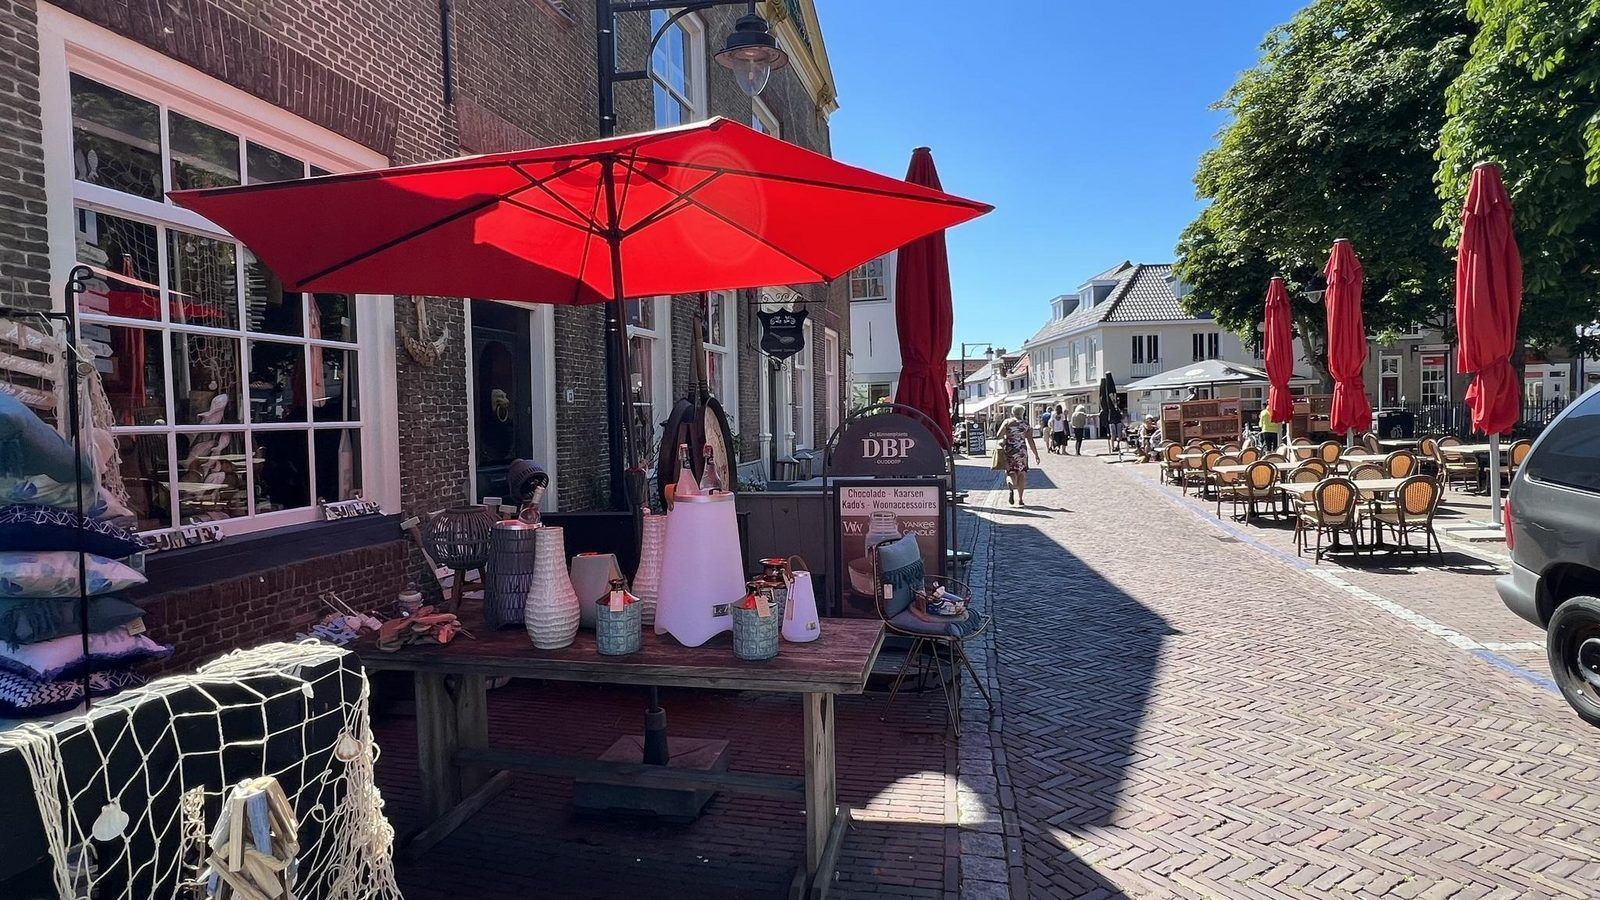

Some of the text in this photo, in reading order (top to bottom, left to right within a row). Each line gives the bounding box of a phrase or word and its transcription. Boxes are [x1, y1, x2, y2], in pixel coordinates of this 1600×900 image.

[862, 438, 915, 458] DBP
[848, 488, 886, 498] Chocolade
[893, 488, 924, 498] Kaarsen
[842, 500, 865, 509] Kado's
[872, 500, 937, 509] Woonaccessoires
